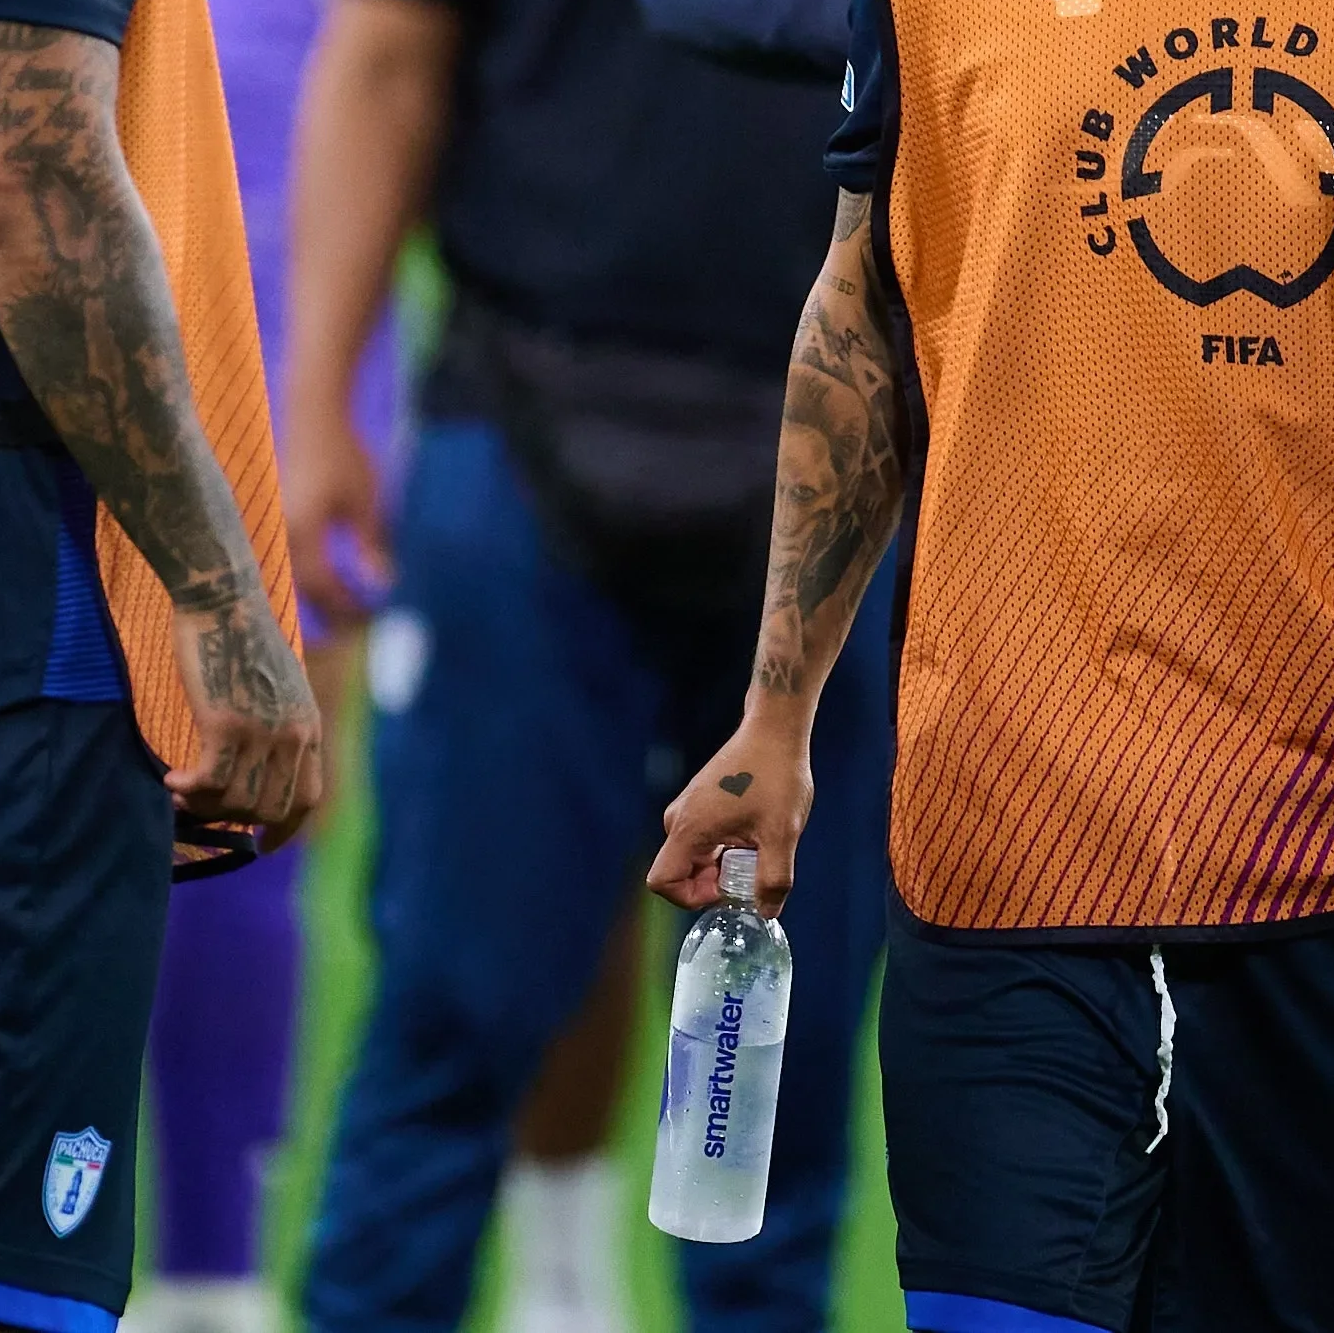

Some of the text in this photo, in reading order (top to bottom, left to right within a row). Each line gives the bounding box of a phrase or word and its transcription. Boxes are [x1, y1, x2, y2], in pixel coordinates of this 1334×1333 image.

[1076, 108, 1115, 257] CLUB
[1113, 16, 1319, 90] WORLD
[1200, 333, 1284, 366] FIFA
[703, 990, 744, 1159] smartwater
